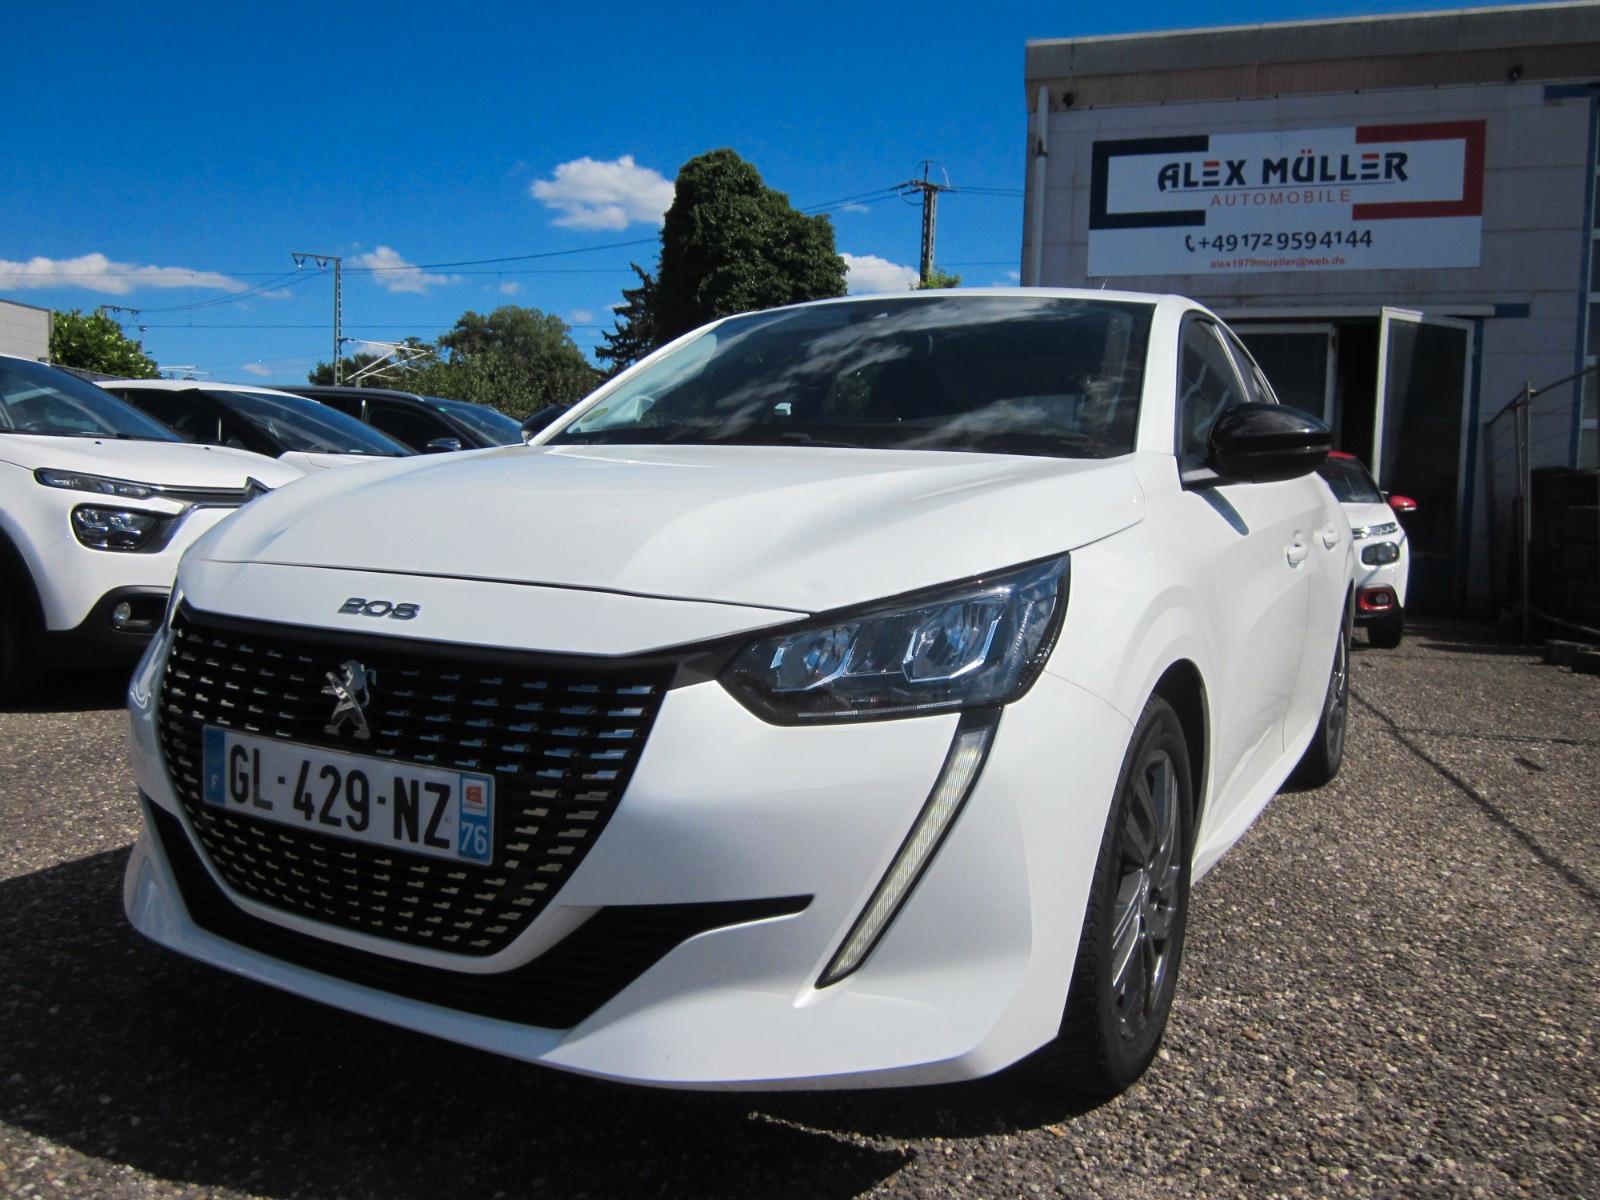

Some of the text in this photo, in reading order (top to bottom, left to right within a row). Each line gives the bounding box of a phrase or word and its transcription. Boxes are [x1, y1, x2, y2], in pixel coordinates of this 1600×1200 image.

[1158, 149, 1408, 192] ALEX MÜLLER
[1210, 189, 1351, 207] AUTOMOBILE
[1210, 256, 1345, 269] alex1979mueller@web.de
[337, 597, 420, 620] 208
[460, 821, 487, 855] 76
